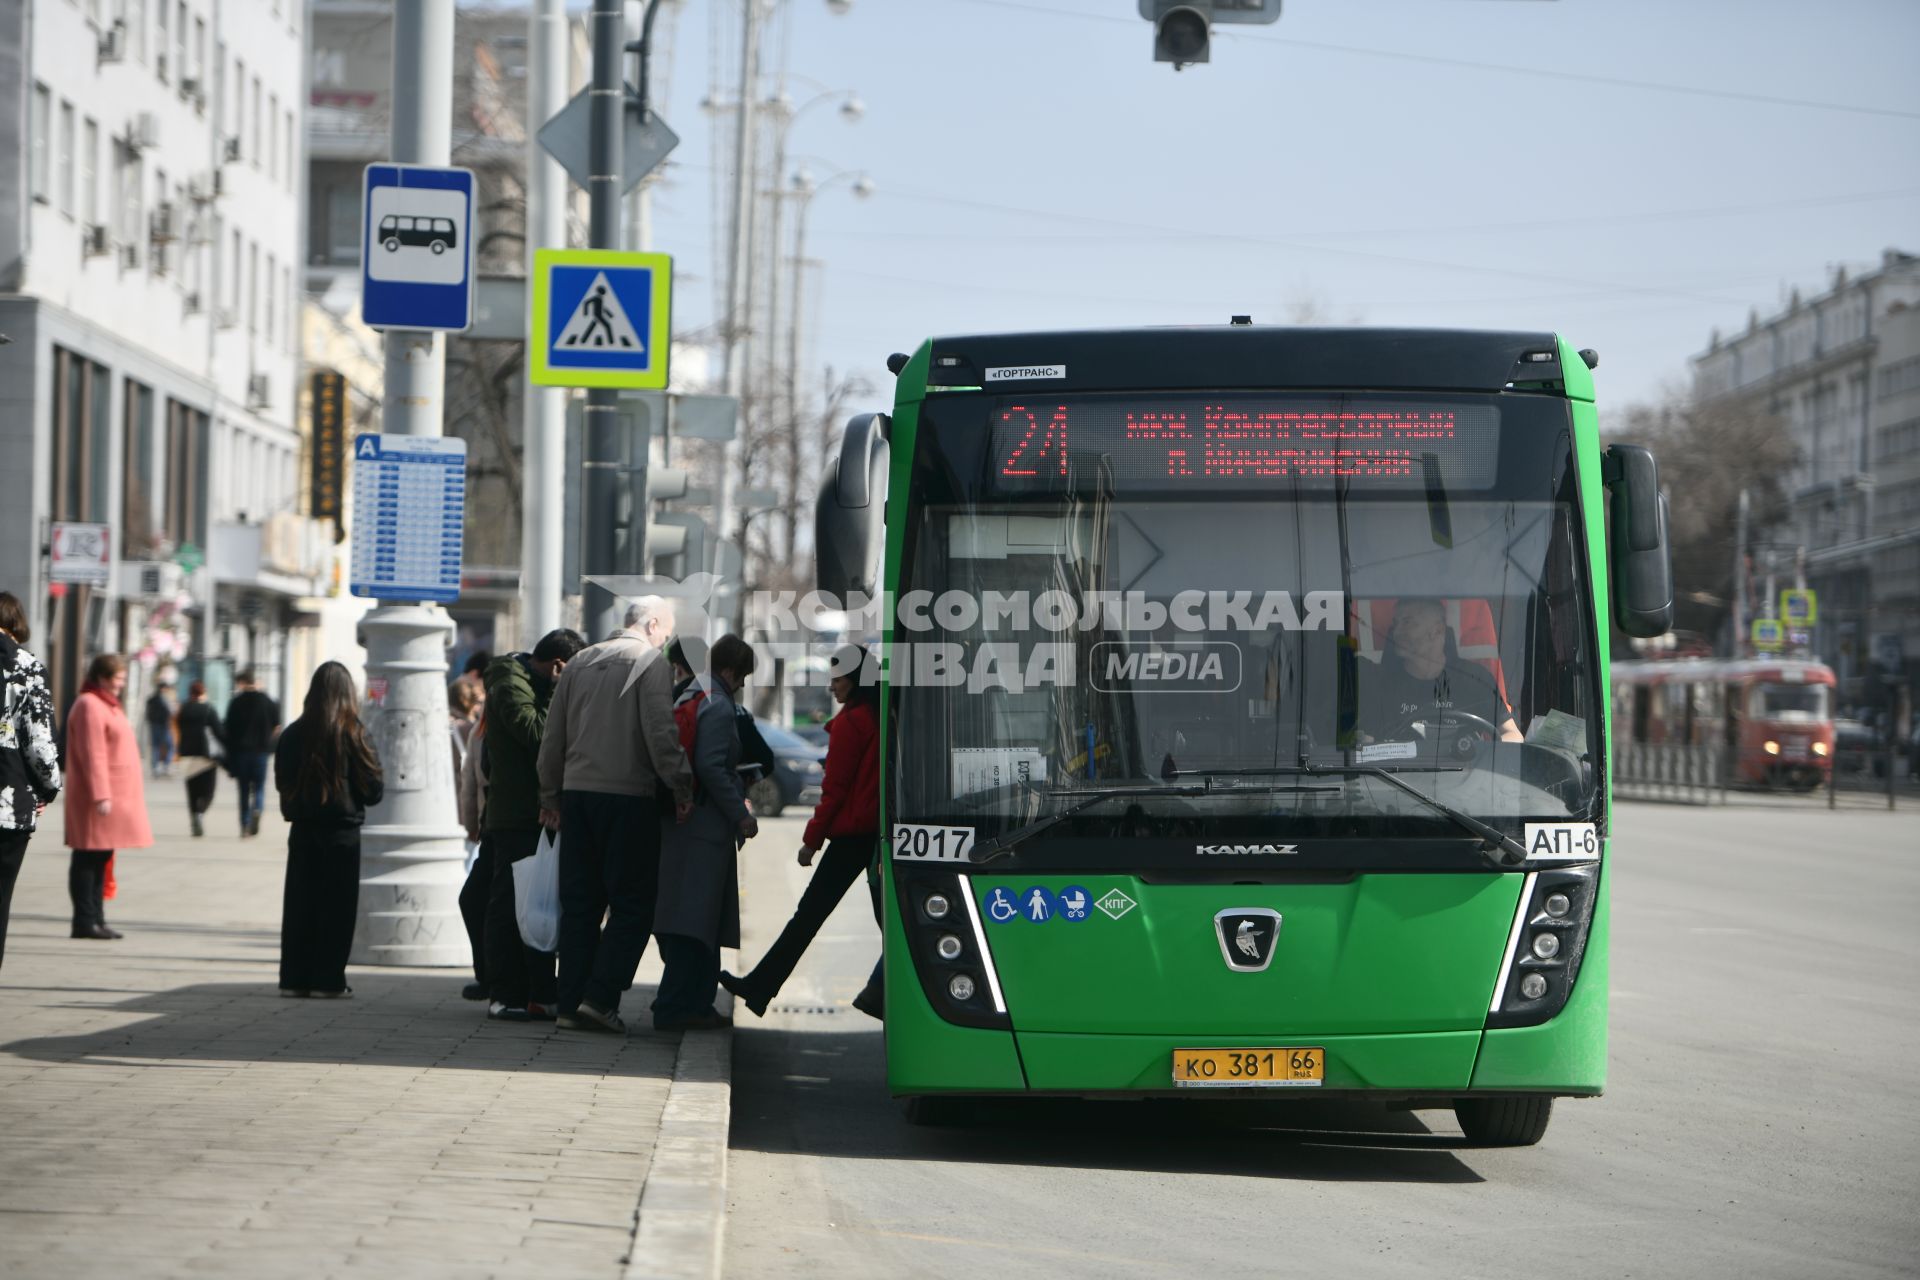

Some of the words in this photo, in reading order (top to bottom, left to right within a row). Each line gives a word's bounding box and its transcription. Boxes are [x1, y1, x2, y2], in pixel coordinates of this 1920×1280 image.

[992, 367, 1059, 379] «ГОРТРАНС»
[358, 438, 377, 458] А
[896, 827, 971, 859] 2017
[1531, 828, 1596, 854] АП-6
[1196, 844, 1298, 855] KAMAZ
[1104, 898, 1128, 909] КПГ
[1186, 1058, 1217, 1078] КО
[1228, 1053, 1275, 1077] 381
[1291, 1051, 1315, 1069] 66
[1293, 1070, 1312, 1078] RUS
